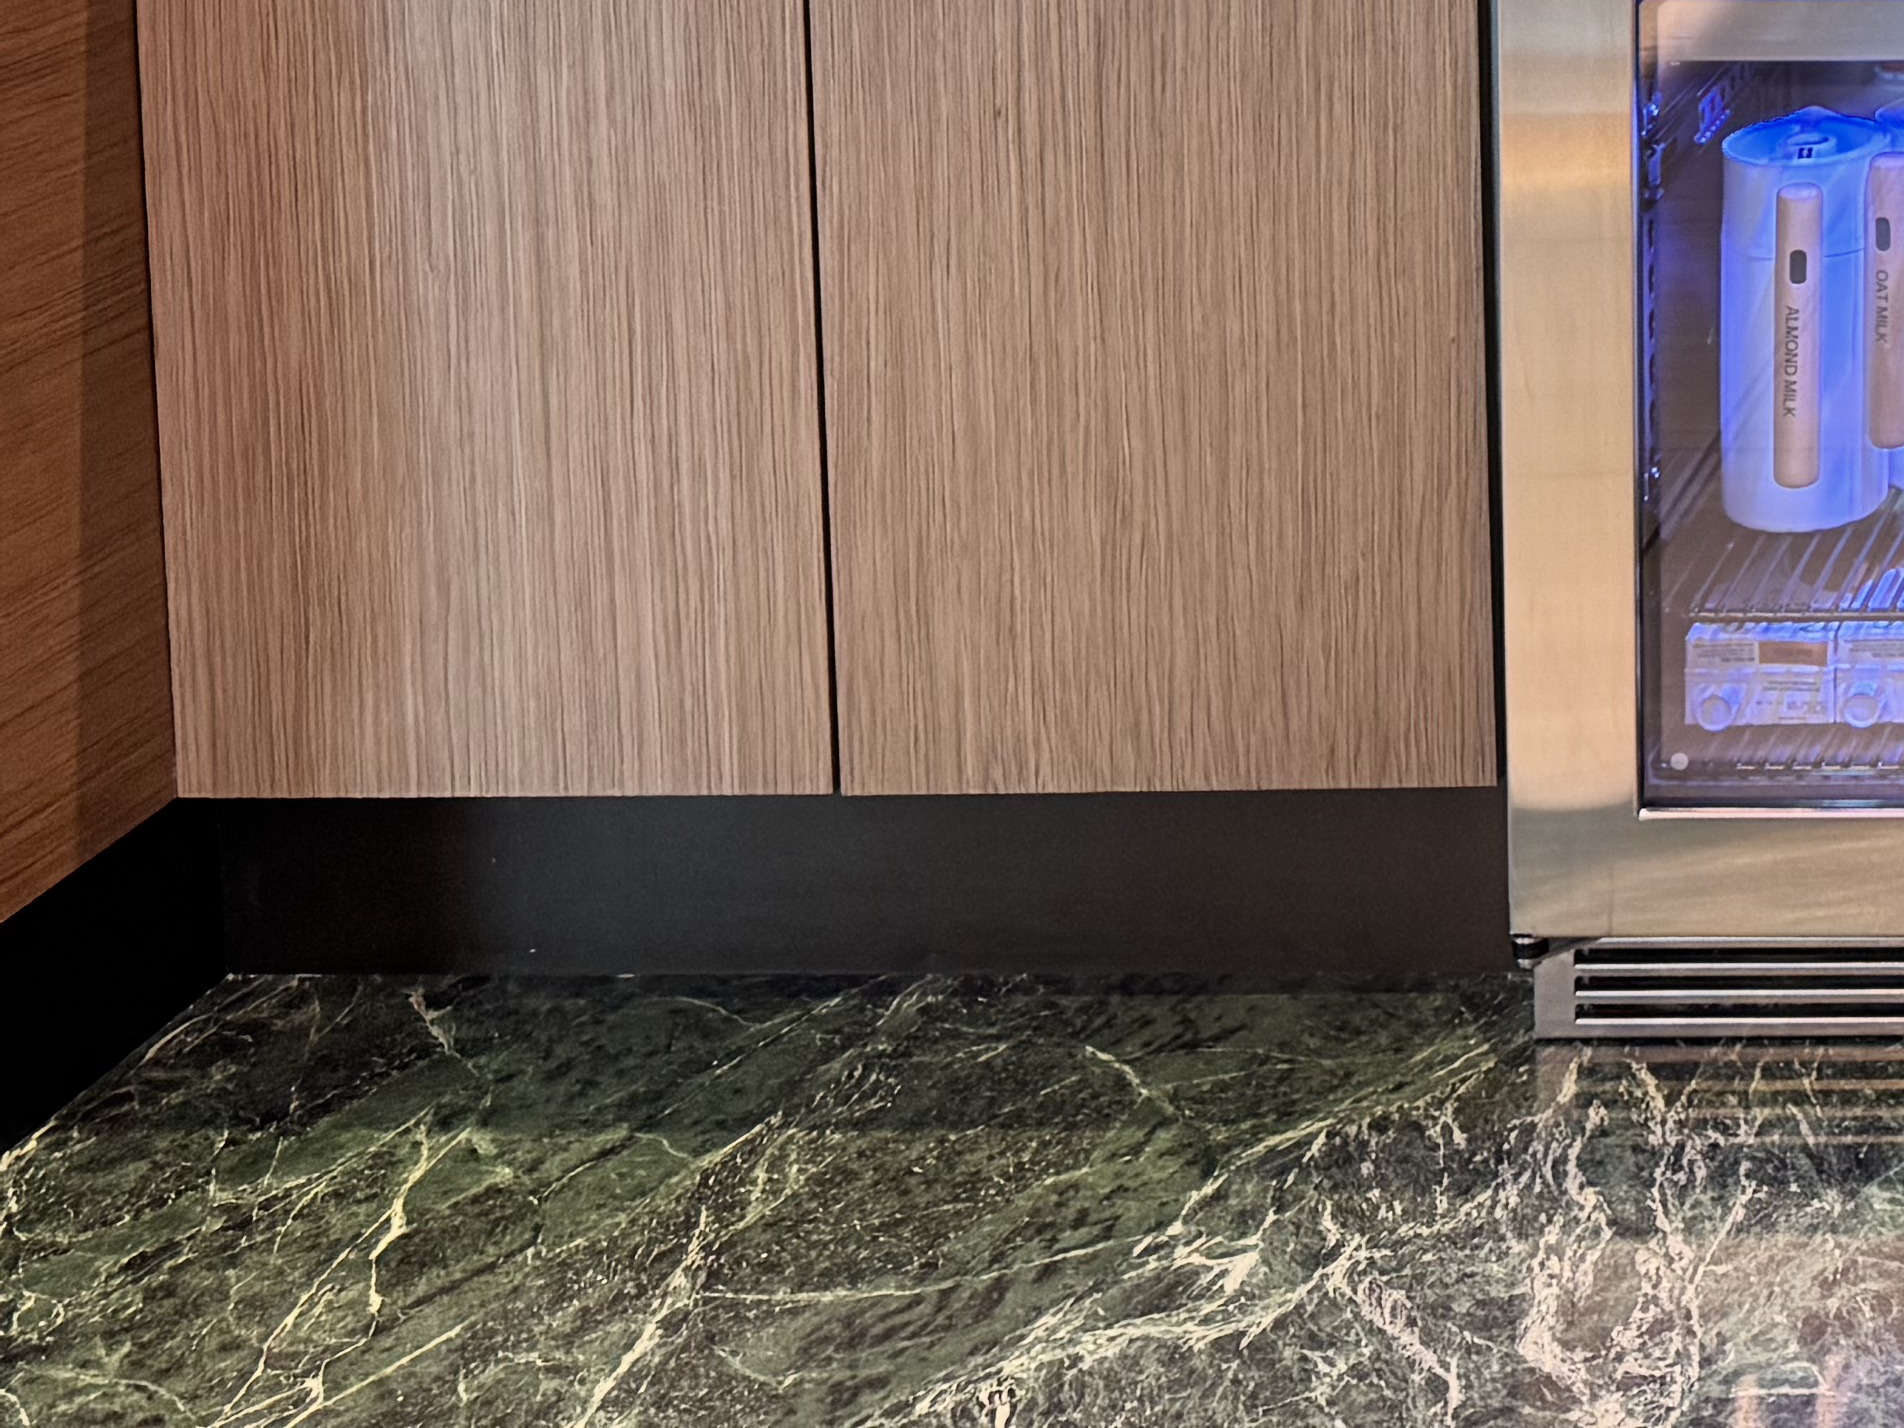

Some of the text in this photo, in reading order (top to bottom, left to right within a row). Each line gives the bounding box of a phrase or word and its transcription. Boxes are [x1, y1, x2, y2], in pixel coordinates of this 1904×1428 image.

[1873, 269, 1889, 345] OAT MILK
[1782, 305, 1800, 418] ALMOND MILK
